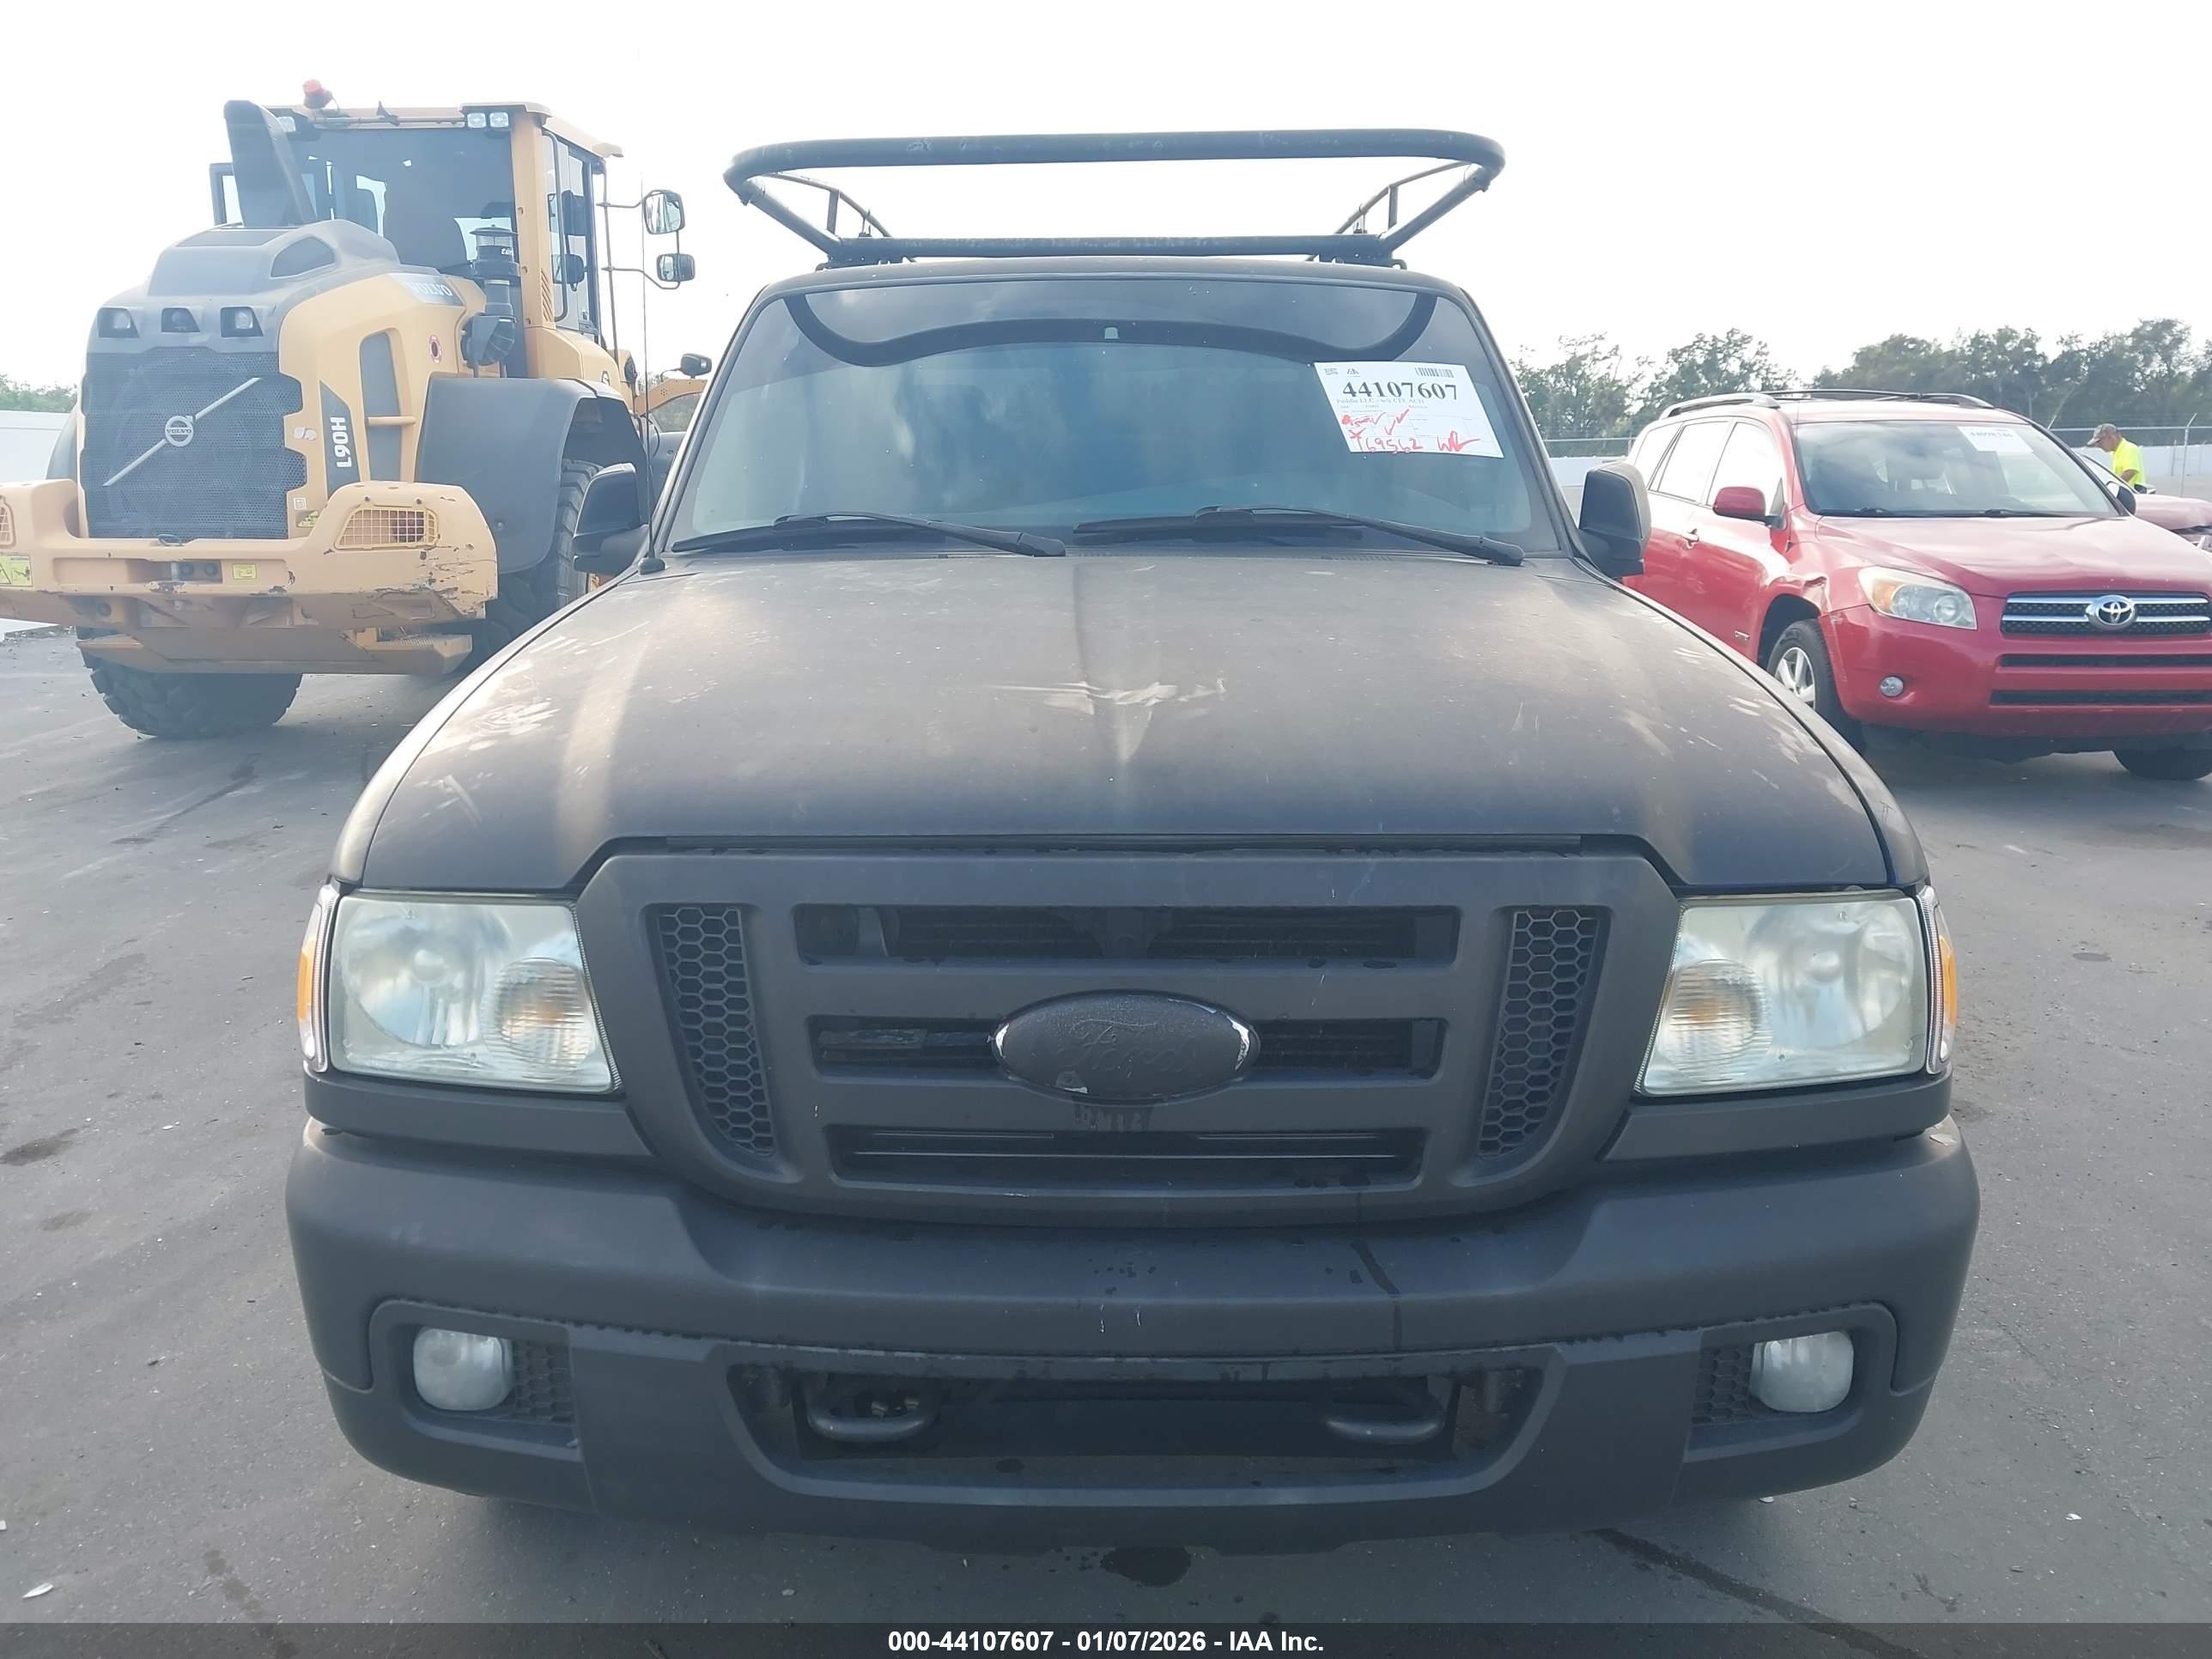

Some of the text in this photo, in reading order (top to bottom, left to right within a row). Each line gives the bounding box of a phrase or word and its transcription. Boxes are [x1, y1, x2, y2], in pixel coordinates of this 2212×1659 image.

[410, 282, 453, 296] VOLVO
[1342, 381, 1457, 400] 44107607
[330, 416, 352, 468] L90H
